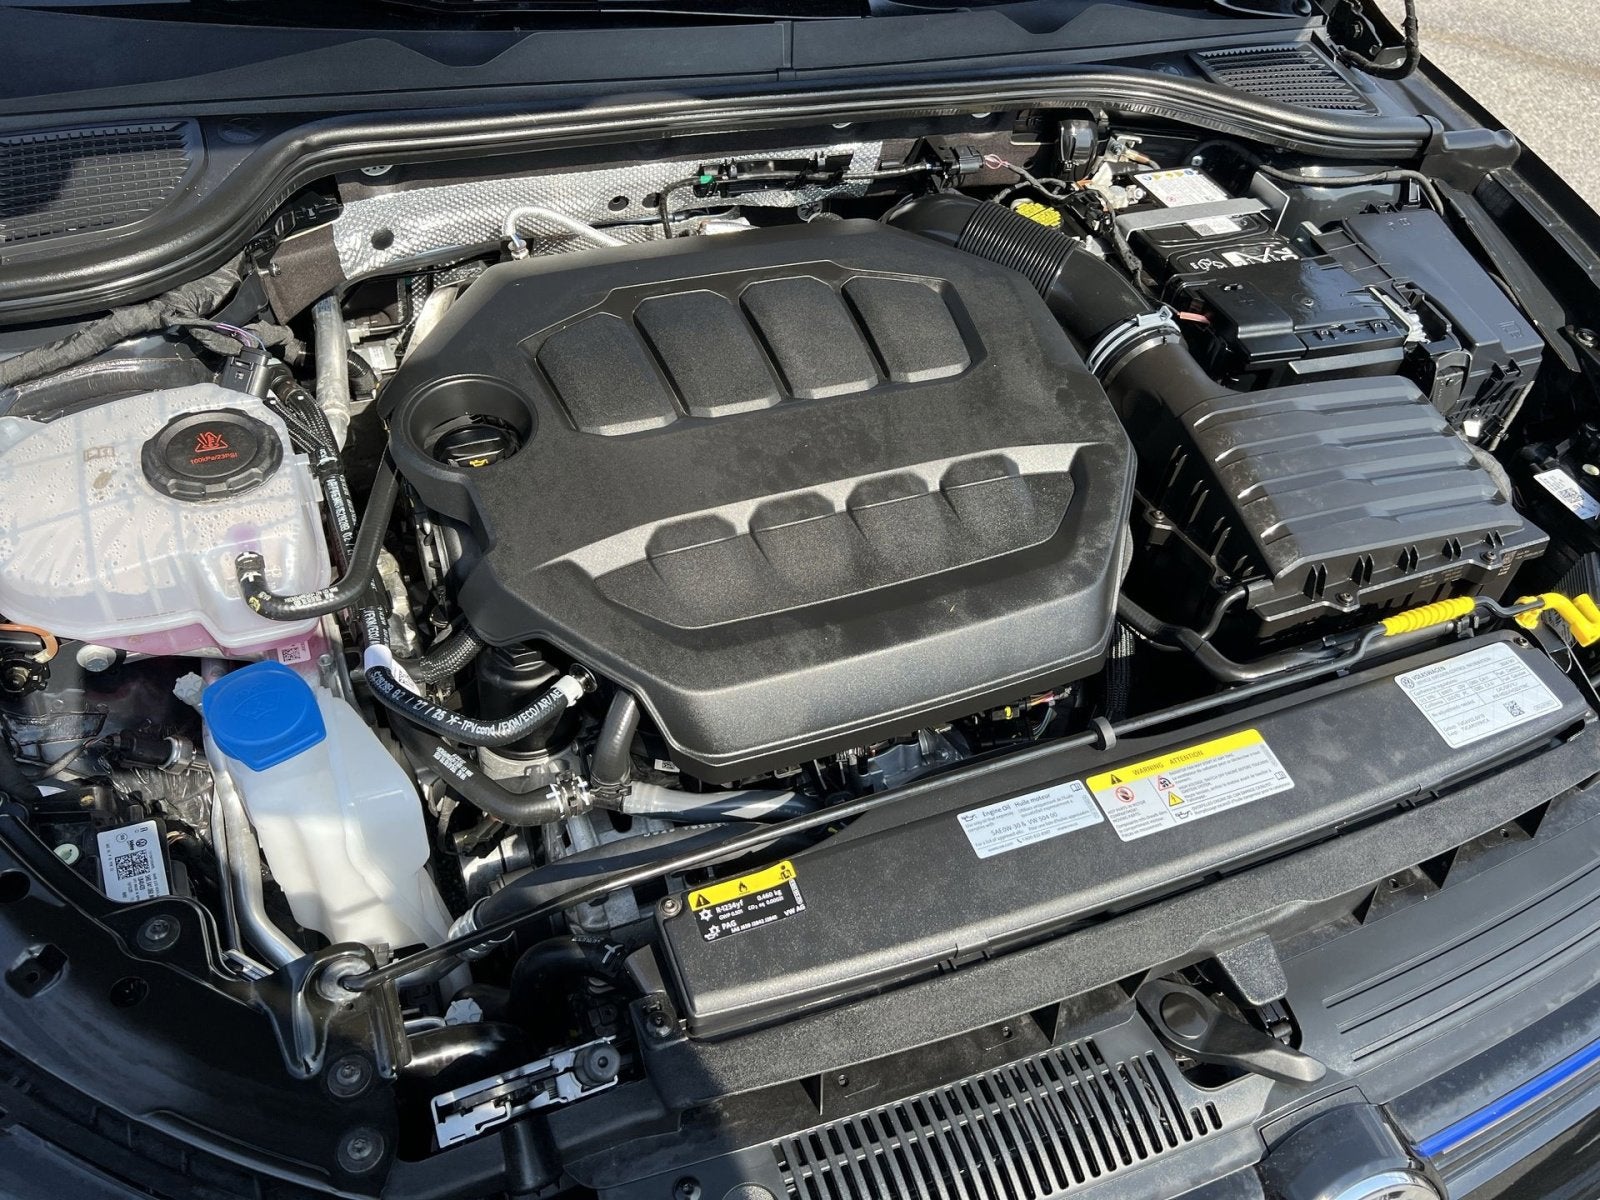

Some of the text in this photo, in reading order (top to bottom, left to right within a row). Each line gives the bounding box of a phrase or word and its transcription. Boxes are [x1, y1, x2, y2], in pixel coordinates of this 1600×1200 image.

[392, 689, 406, 701] 02
[413, 699, 427, 711] 27
[432, 708, 447, 721] 25
[1133, 762, 1164, 775] WARNING
[1170, 751, 1204, 764] ATTENTION
[982, 808, 1002, 817] Engine
[1030, 794, 1050, 803] moteur
[757, 892, 773, 901] 0.460
[716, 899, 743, 913] R-1234yf
[784, 904, 806, 916] VW AG
[722, 920, 737, 930] PAG
